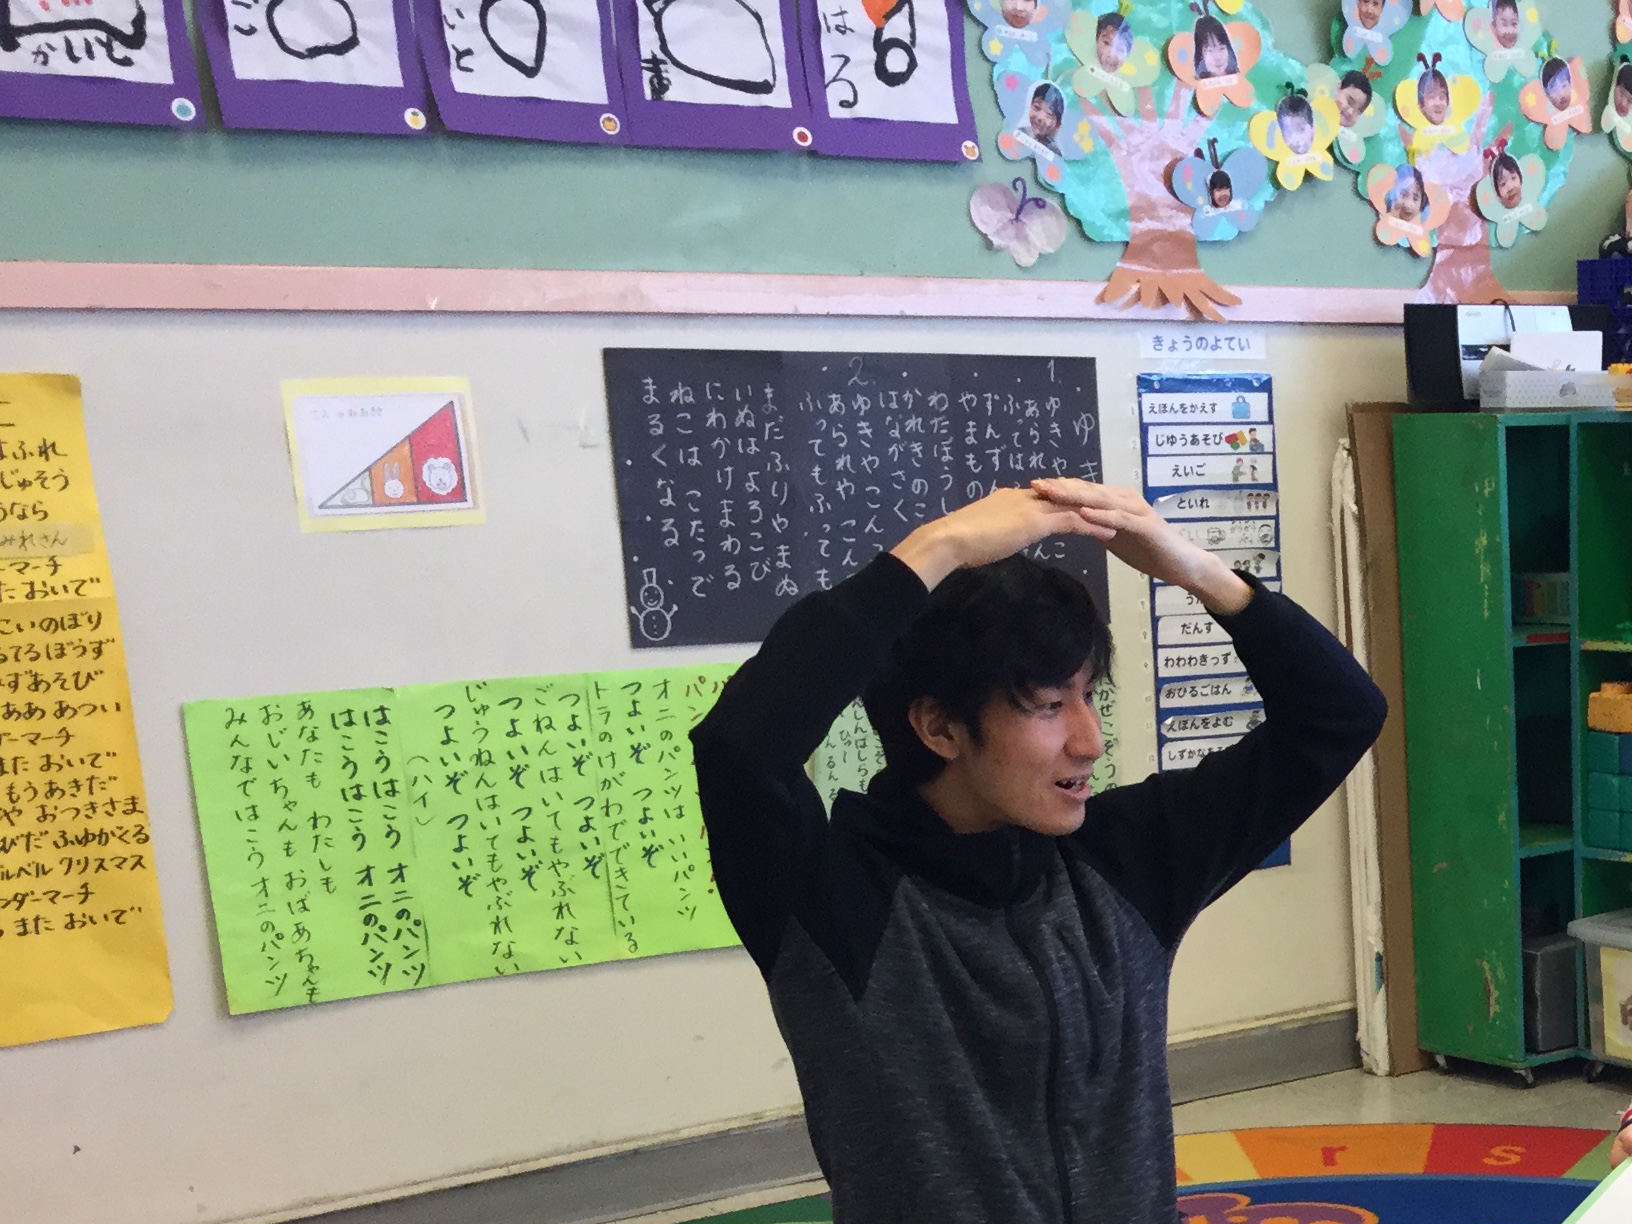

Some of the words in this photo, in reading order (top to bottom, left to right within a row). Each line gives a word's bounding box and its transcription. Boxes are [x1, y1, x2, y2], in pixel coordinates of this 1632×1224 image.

[1152, 335, 1251, 353] きょうのよてい
[1148, 402, 1218, 415] えほんをかえす
[1003, 394, 1025, 488] ふっては
[1025, 399, 1046, 478] あられ
[1172, 463, 1207, 478] えいご
[1176, 496, 1210, 510] といれ
[1180, 620, 1214, 636] だんす
[1164, 651, 1232, 669] わわわきっず
[0, 669, 104, 694] ずあそび
[1165, 683, 1232, 699] おひるごはん
[1166, 715, 1234, 734] えほんをよむ
[39, 751, 117, 772] おいで
[36, 795, 144, 825] おつきさま
[59, 854, 147, 876] クリスマス
[64, 906, 142, 930] おいで
